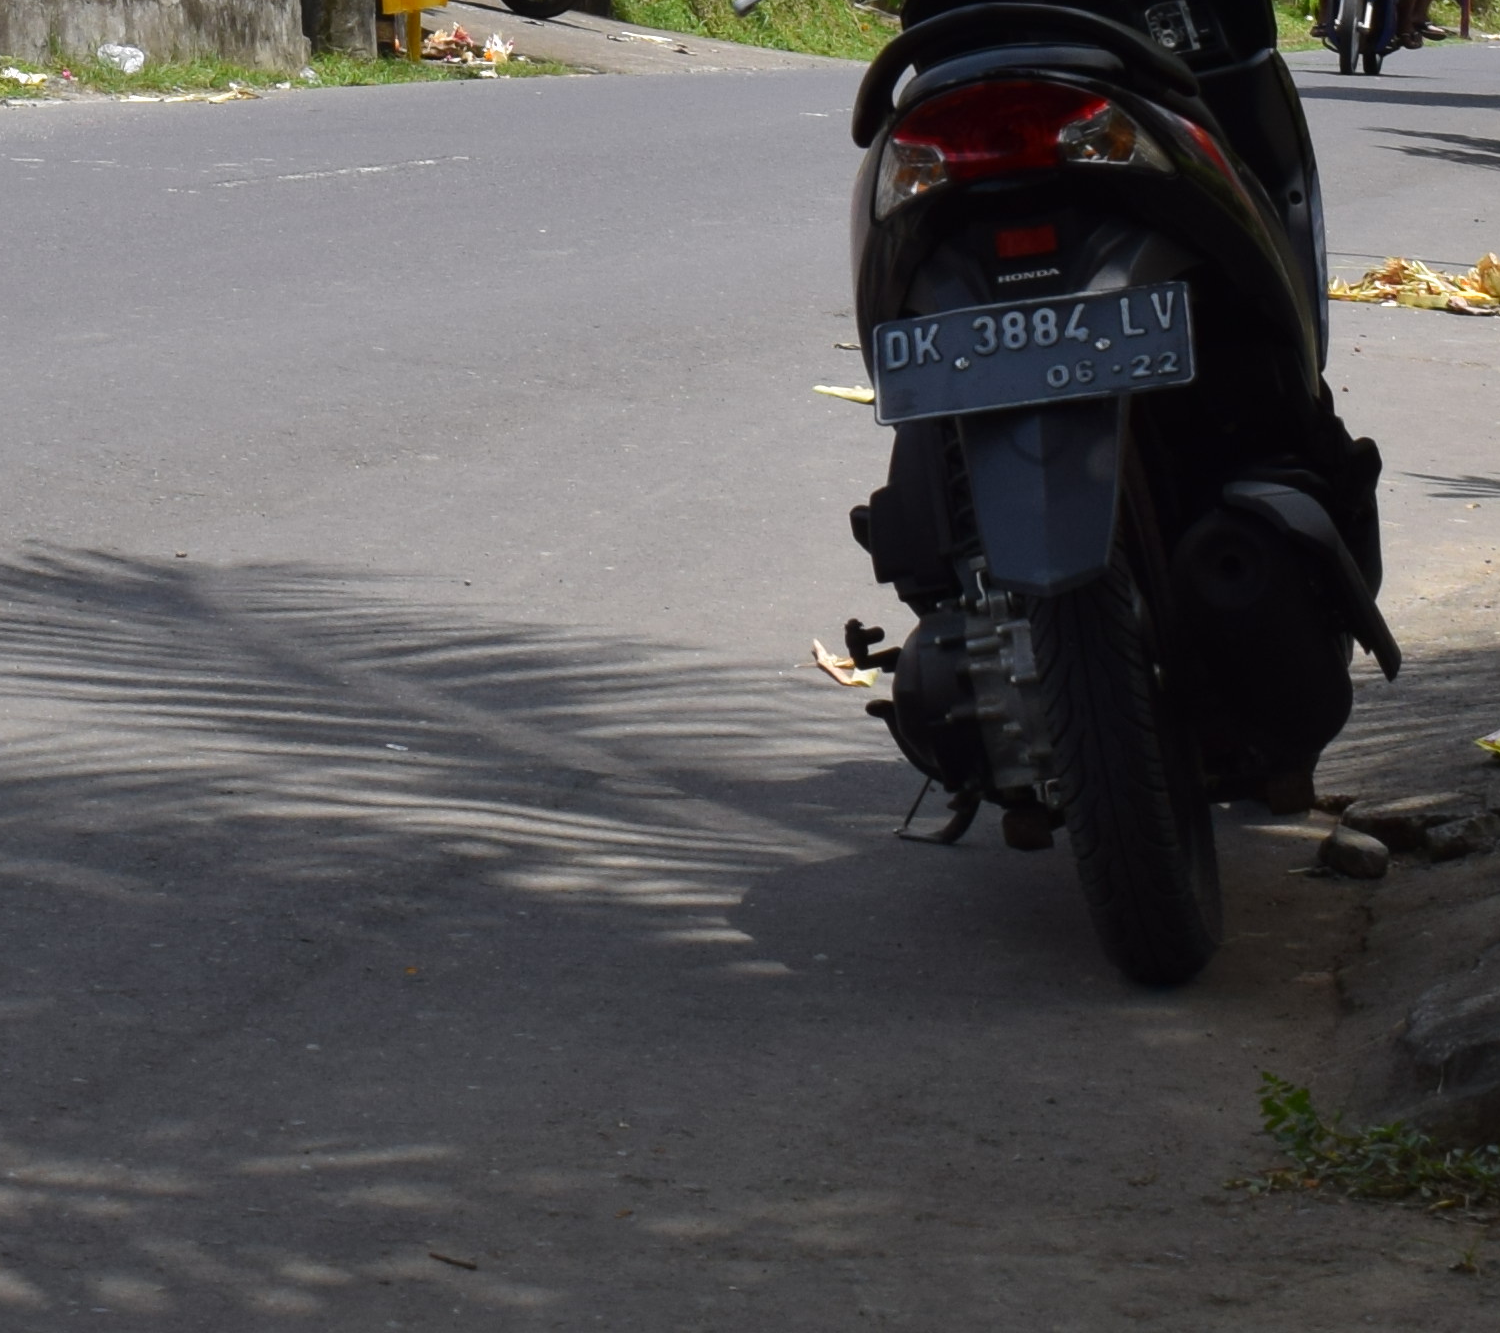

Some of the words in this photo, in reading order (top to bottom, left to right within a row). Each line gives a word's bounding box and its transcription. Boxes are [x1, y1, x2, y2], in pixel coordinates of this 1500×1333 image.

[998, 267, 1060, 284] HONDA
[885, 322, 941, 370] DK
[972, 303, 1089, 356] 3884
[1120, 291, 1175, 336] LV
[1046, 360, 1094, 389] 06
